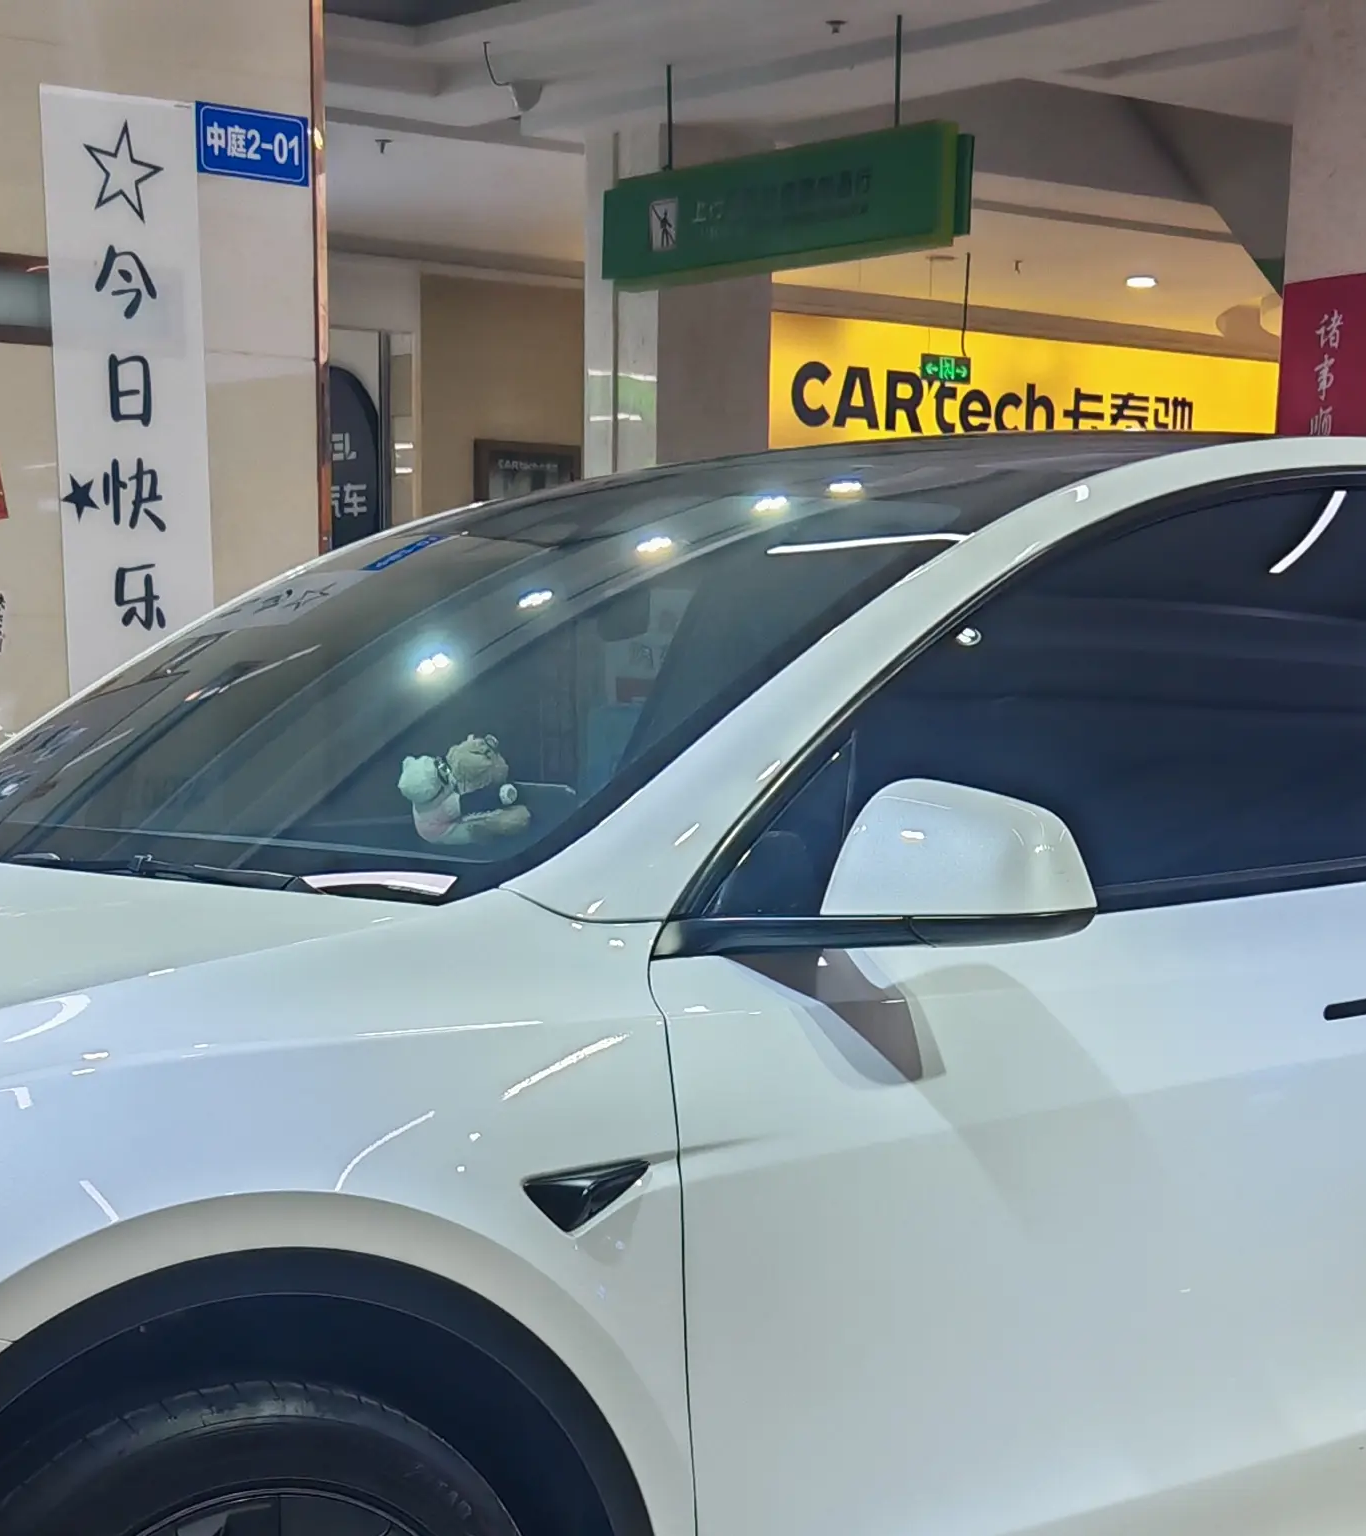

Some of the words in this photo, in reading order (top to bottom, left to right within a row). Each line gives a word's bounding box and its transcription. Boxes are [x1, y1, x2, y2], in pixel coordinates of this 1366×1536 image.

[206, 121, 300, 166] 中庭2-01
[791, 361, 1055, 434] CARtech
[1307, 308, 1345, 436] 诸事顺
[95, 244, 166, 631] 今日快乐
